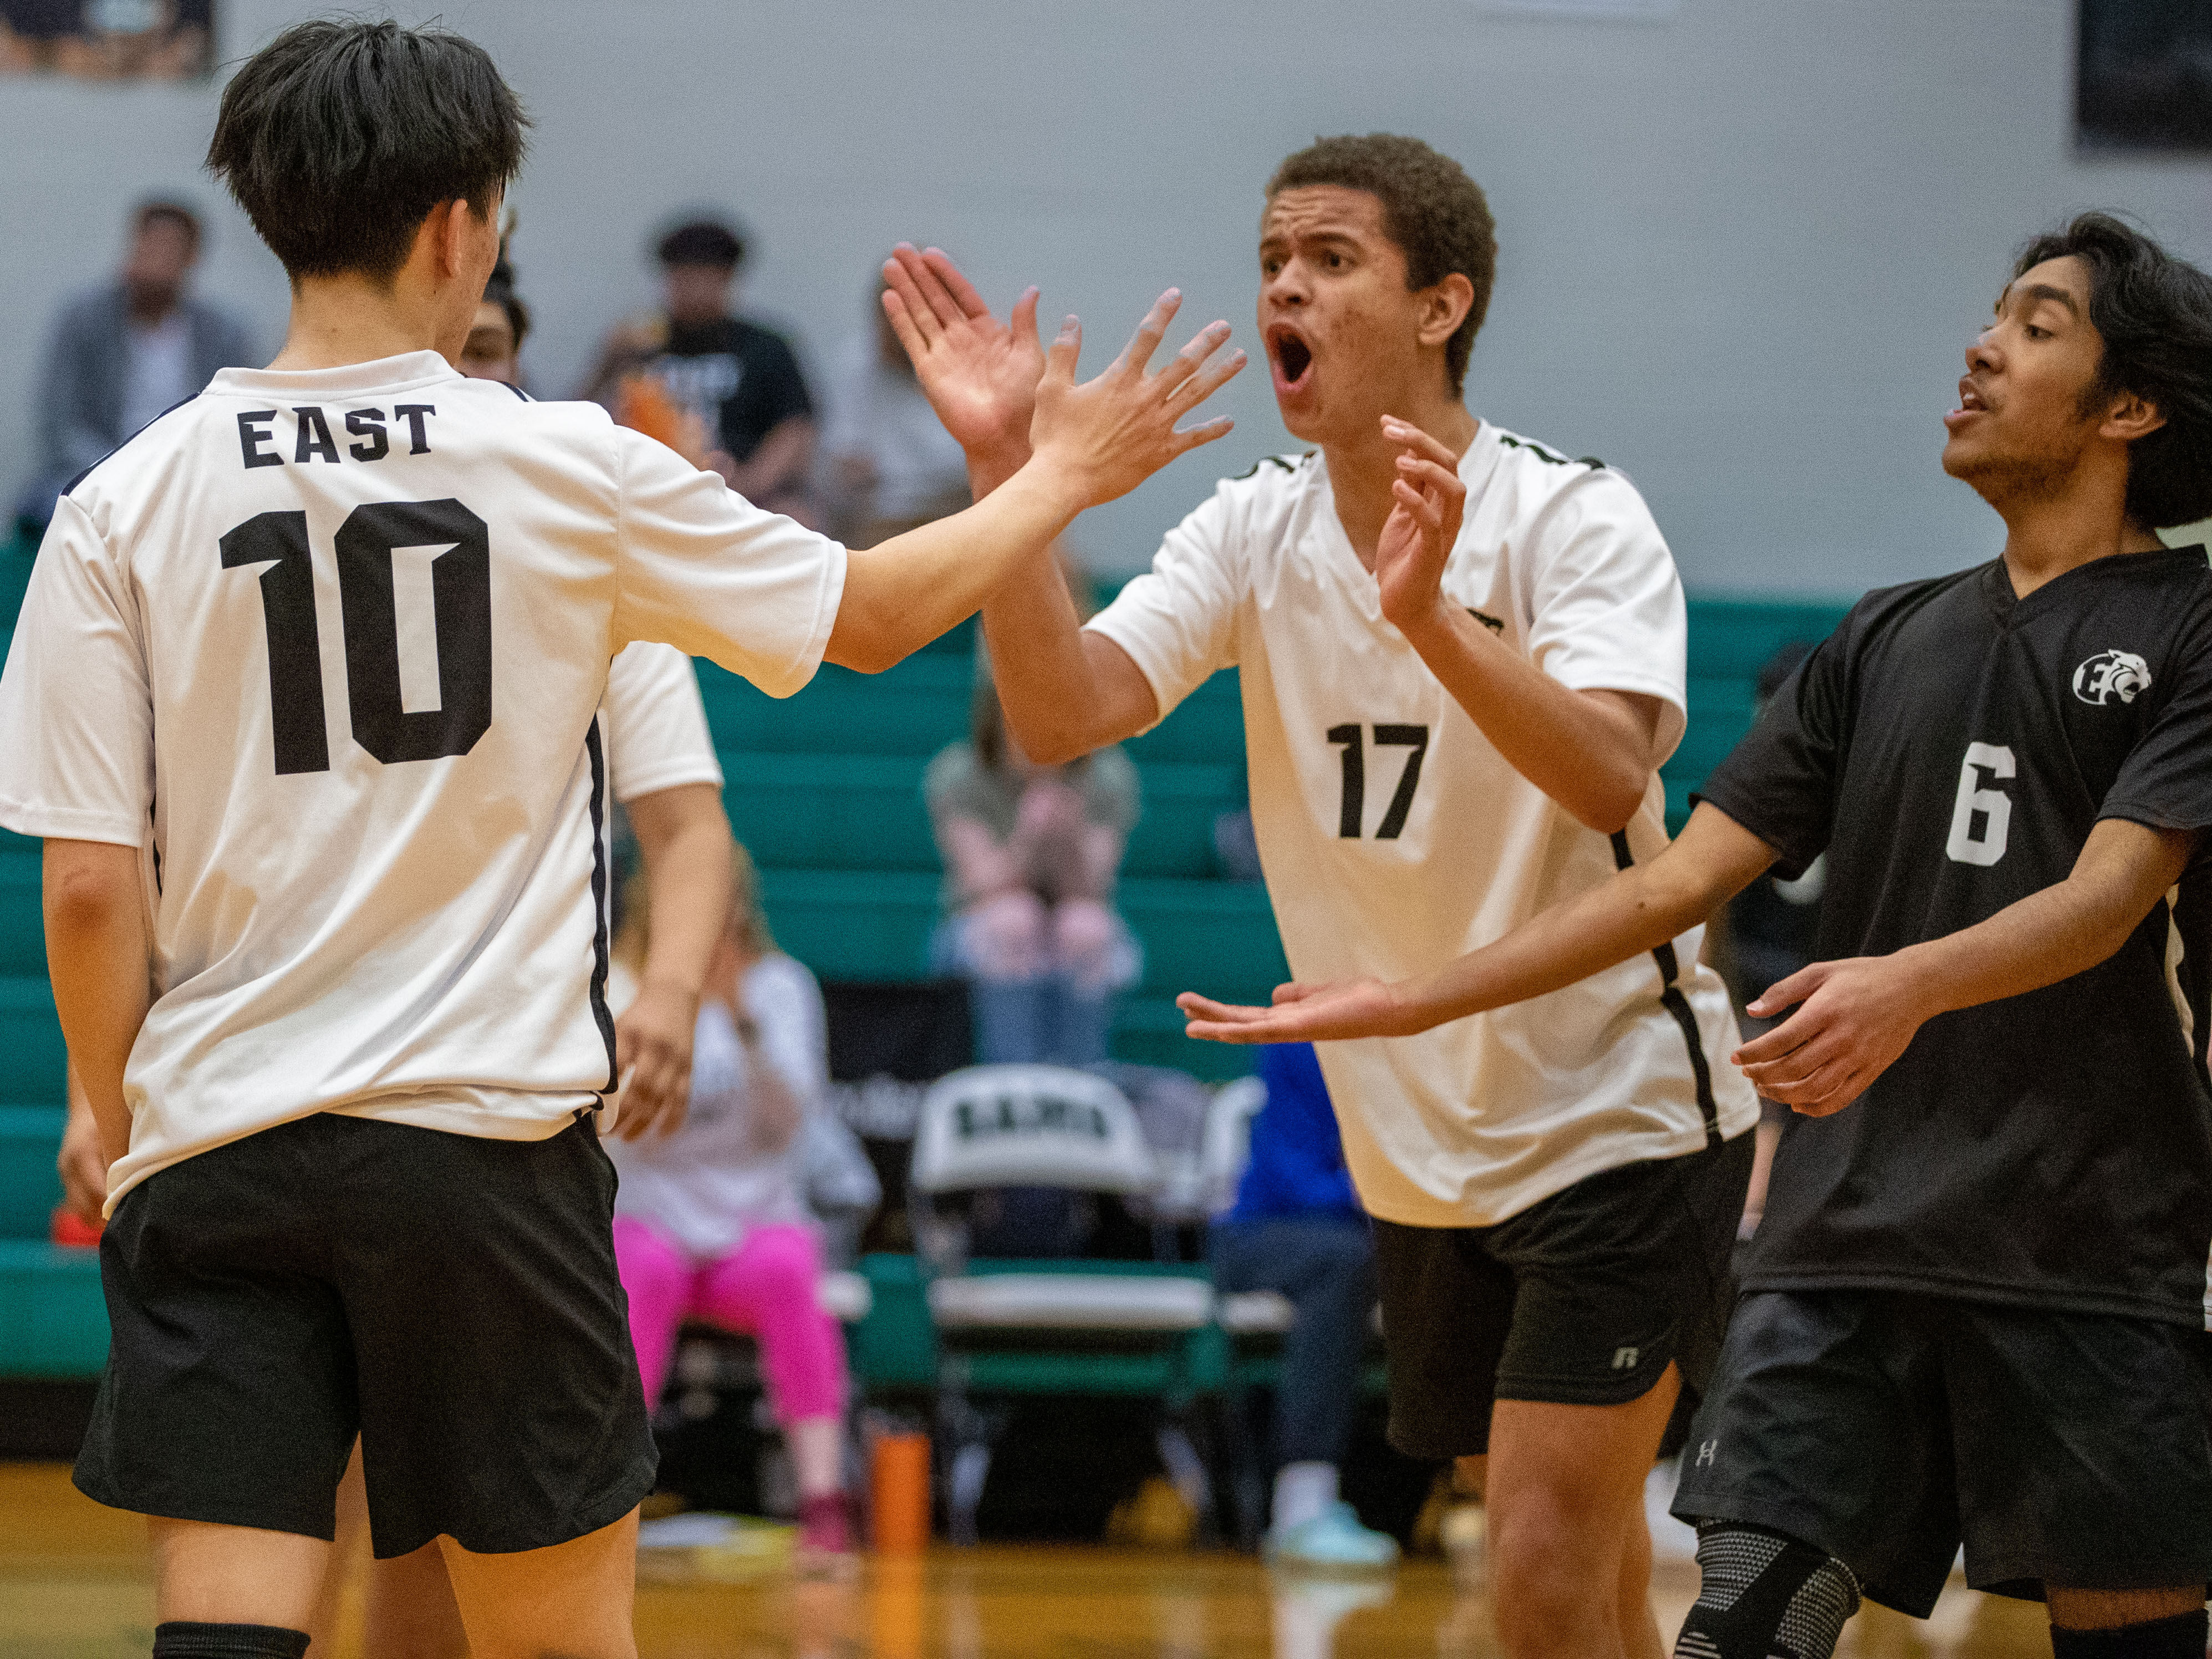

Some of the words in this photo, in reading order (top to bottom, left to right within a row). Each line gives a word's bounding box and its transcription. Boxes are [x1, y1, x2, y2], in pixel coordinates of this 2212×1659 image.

[237, 404, 436, 469] EAST
[218, 497, 492, 776] 10
[1327, 724, 1429, 839] 17
[1946, 741, 2016, 867] 6
